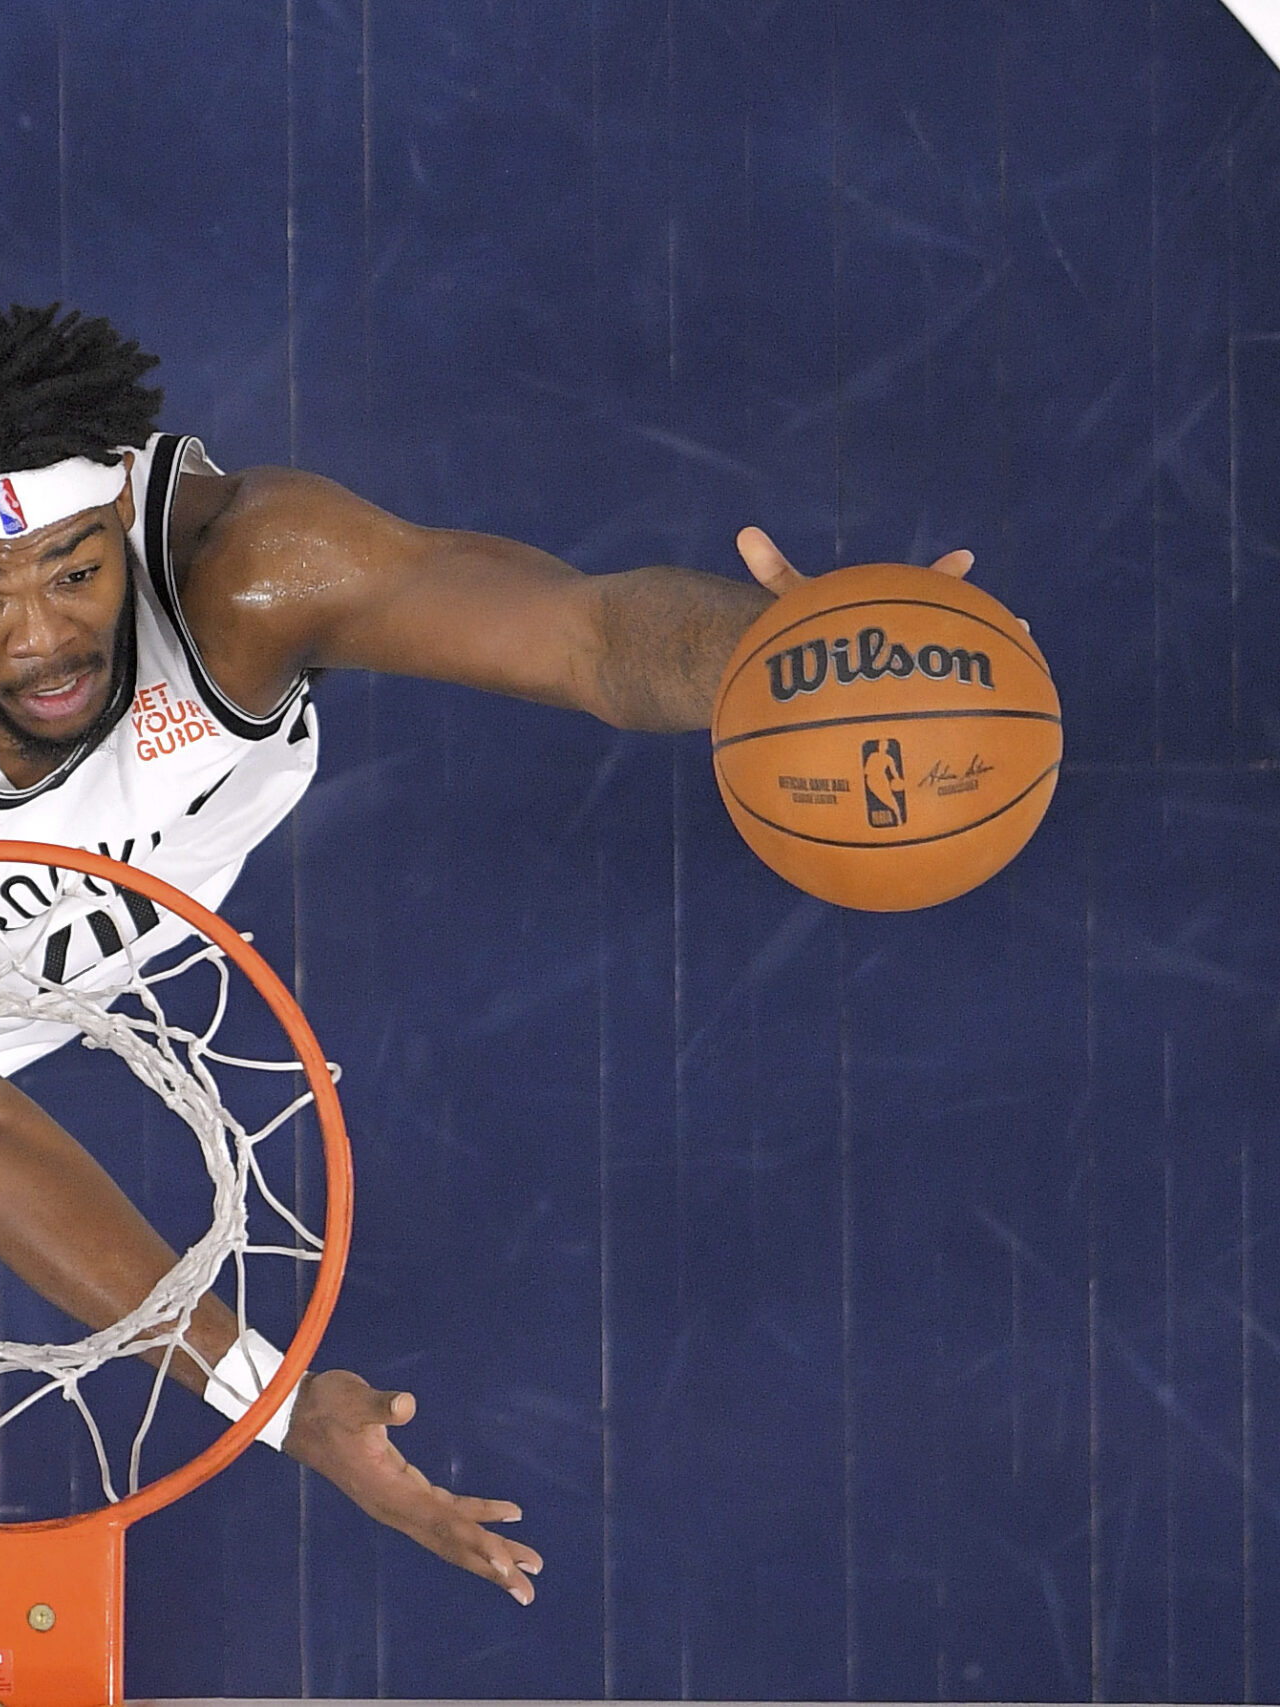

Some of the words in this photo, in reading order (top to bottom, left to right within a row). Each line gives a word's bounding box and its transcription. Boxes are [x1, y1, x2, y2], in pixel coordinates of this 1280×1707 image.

[765, 627, 995, 703] Wilson
[131, 700, 206, 738] YOUR
[137, 719, 221, 761] GUIDE
